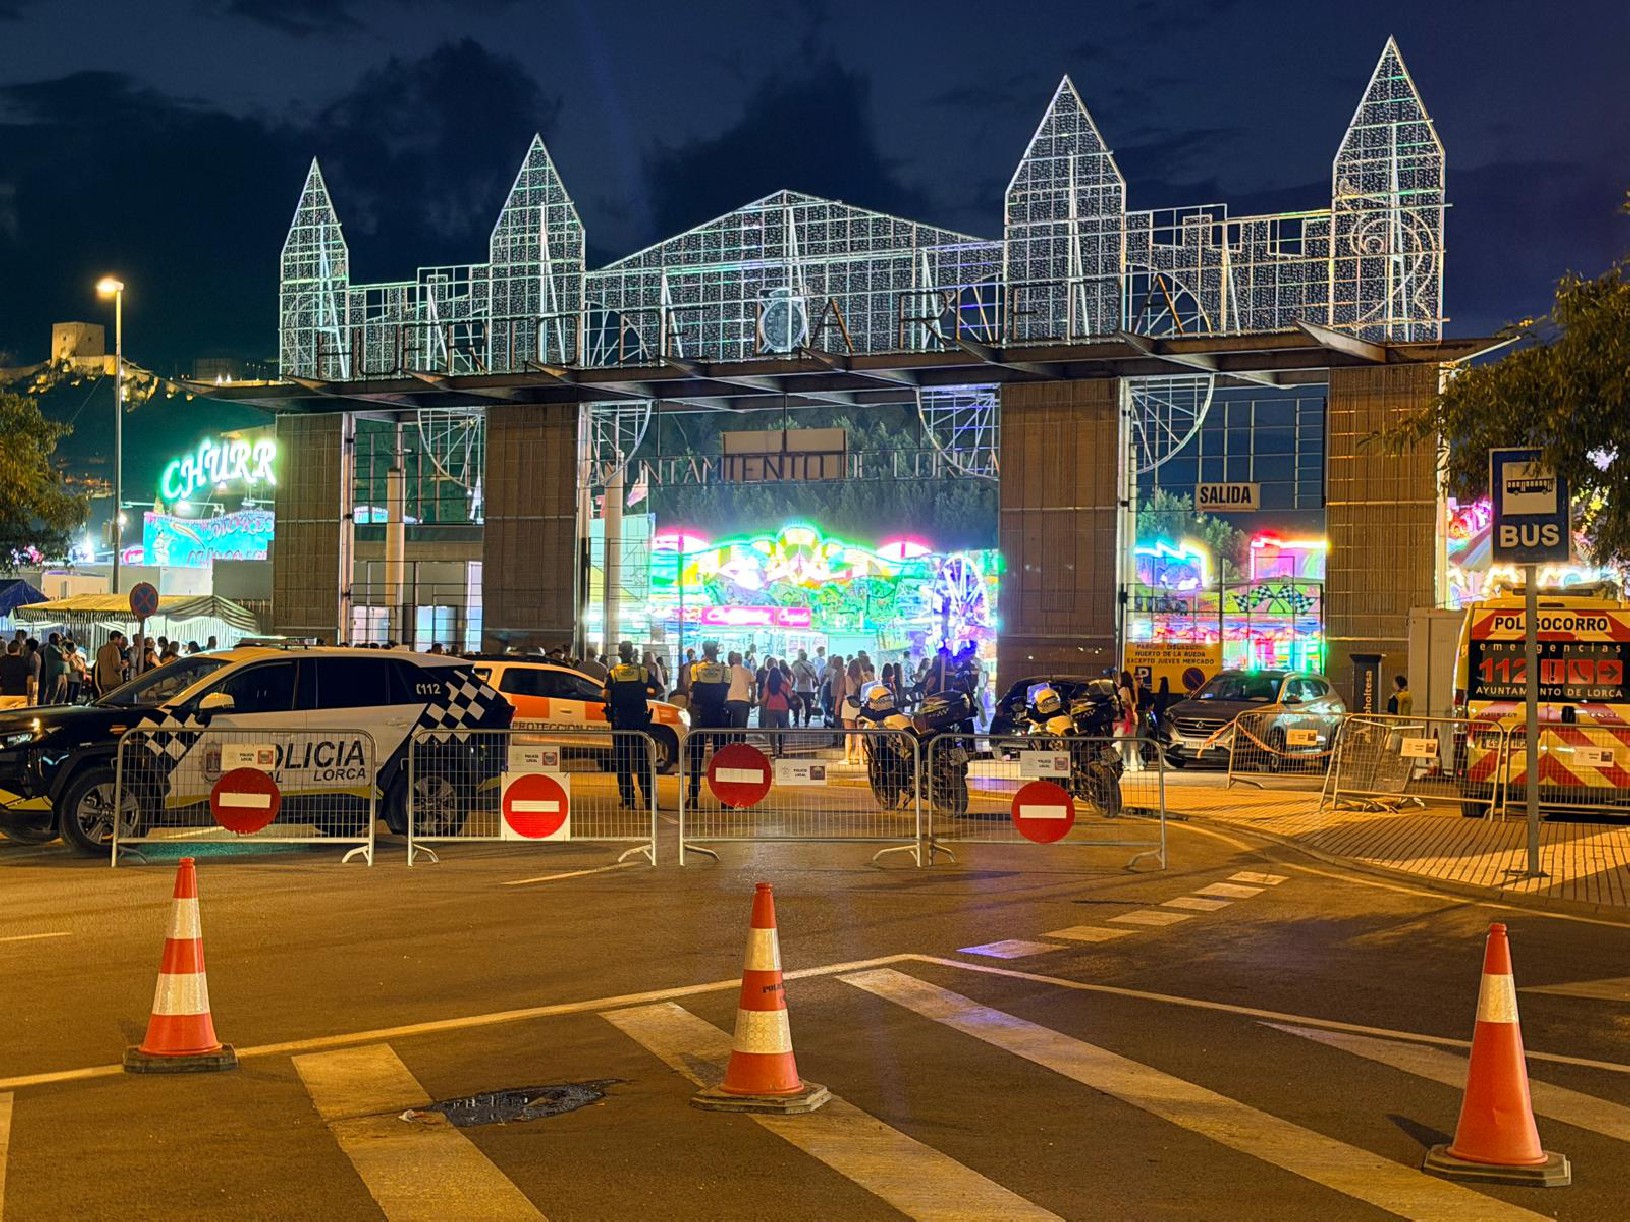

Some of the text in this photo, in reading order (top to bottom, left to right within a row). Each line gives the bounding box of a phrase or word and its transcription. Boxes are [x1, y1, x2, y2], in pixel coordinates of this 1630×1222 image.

[1200, 485, 1252, 504] SALIDA
[1500, 524, 1559, 547] BUS
[1479, 657, 1527, 683] 112
[1476, 686, 1561, 696] AYUNTAMNTO
[1587, 689, 1623, 698] LORCA
[314, 768, 366, 782] LORCA
